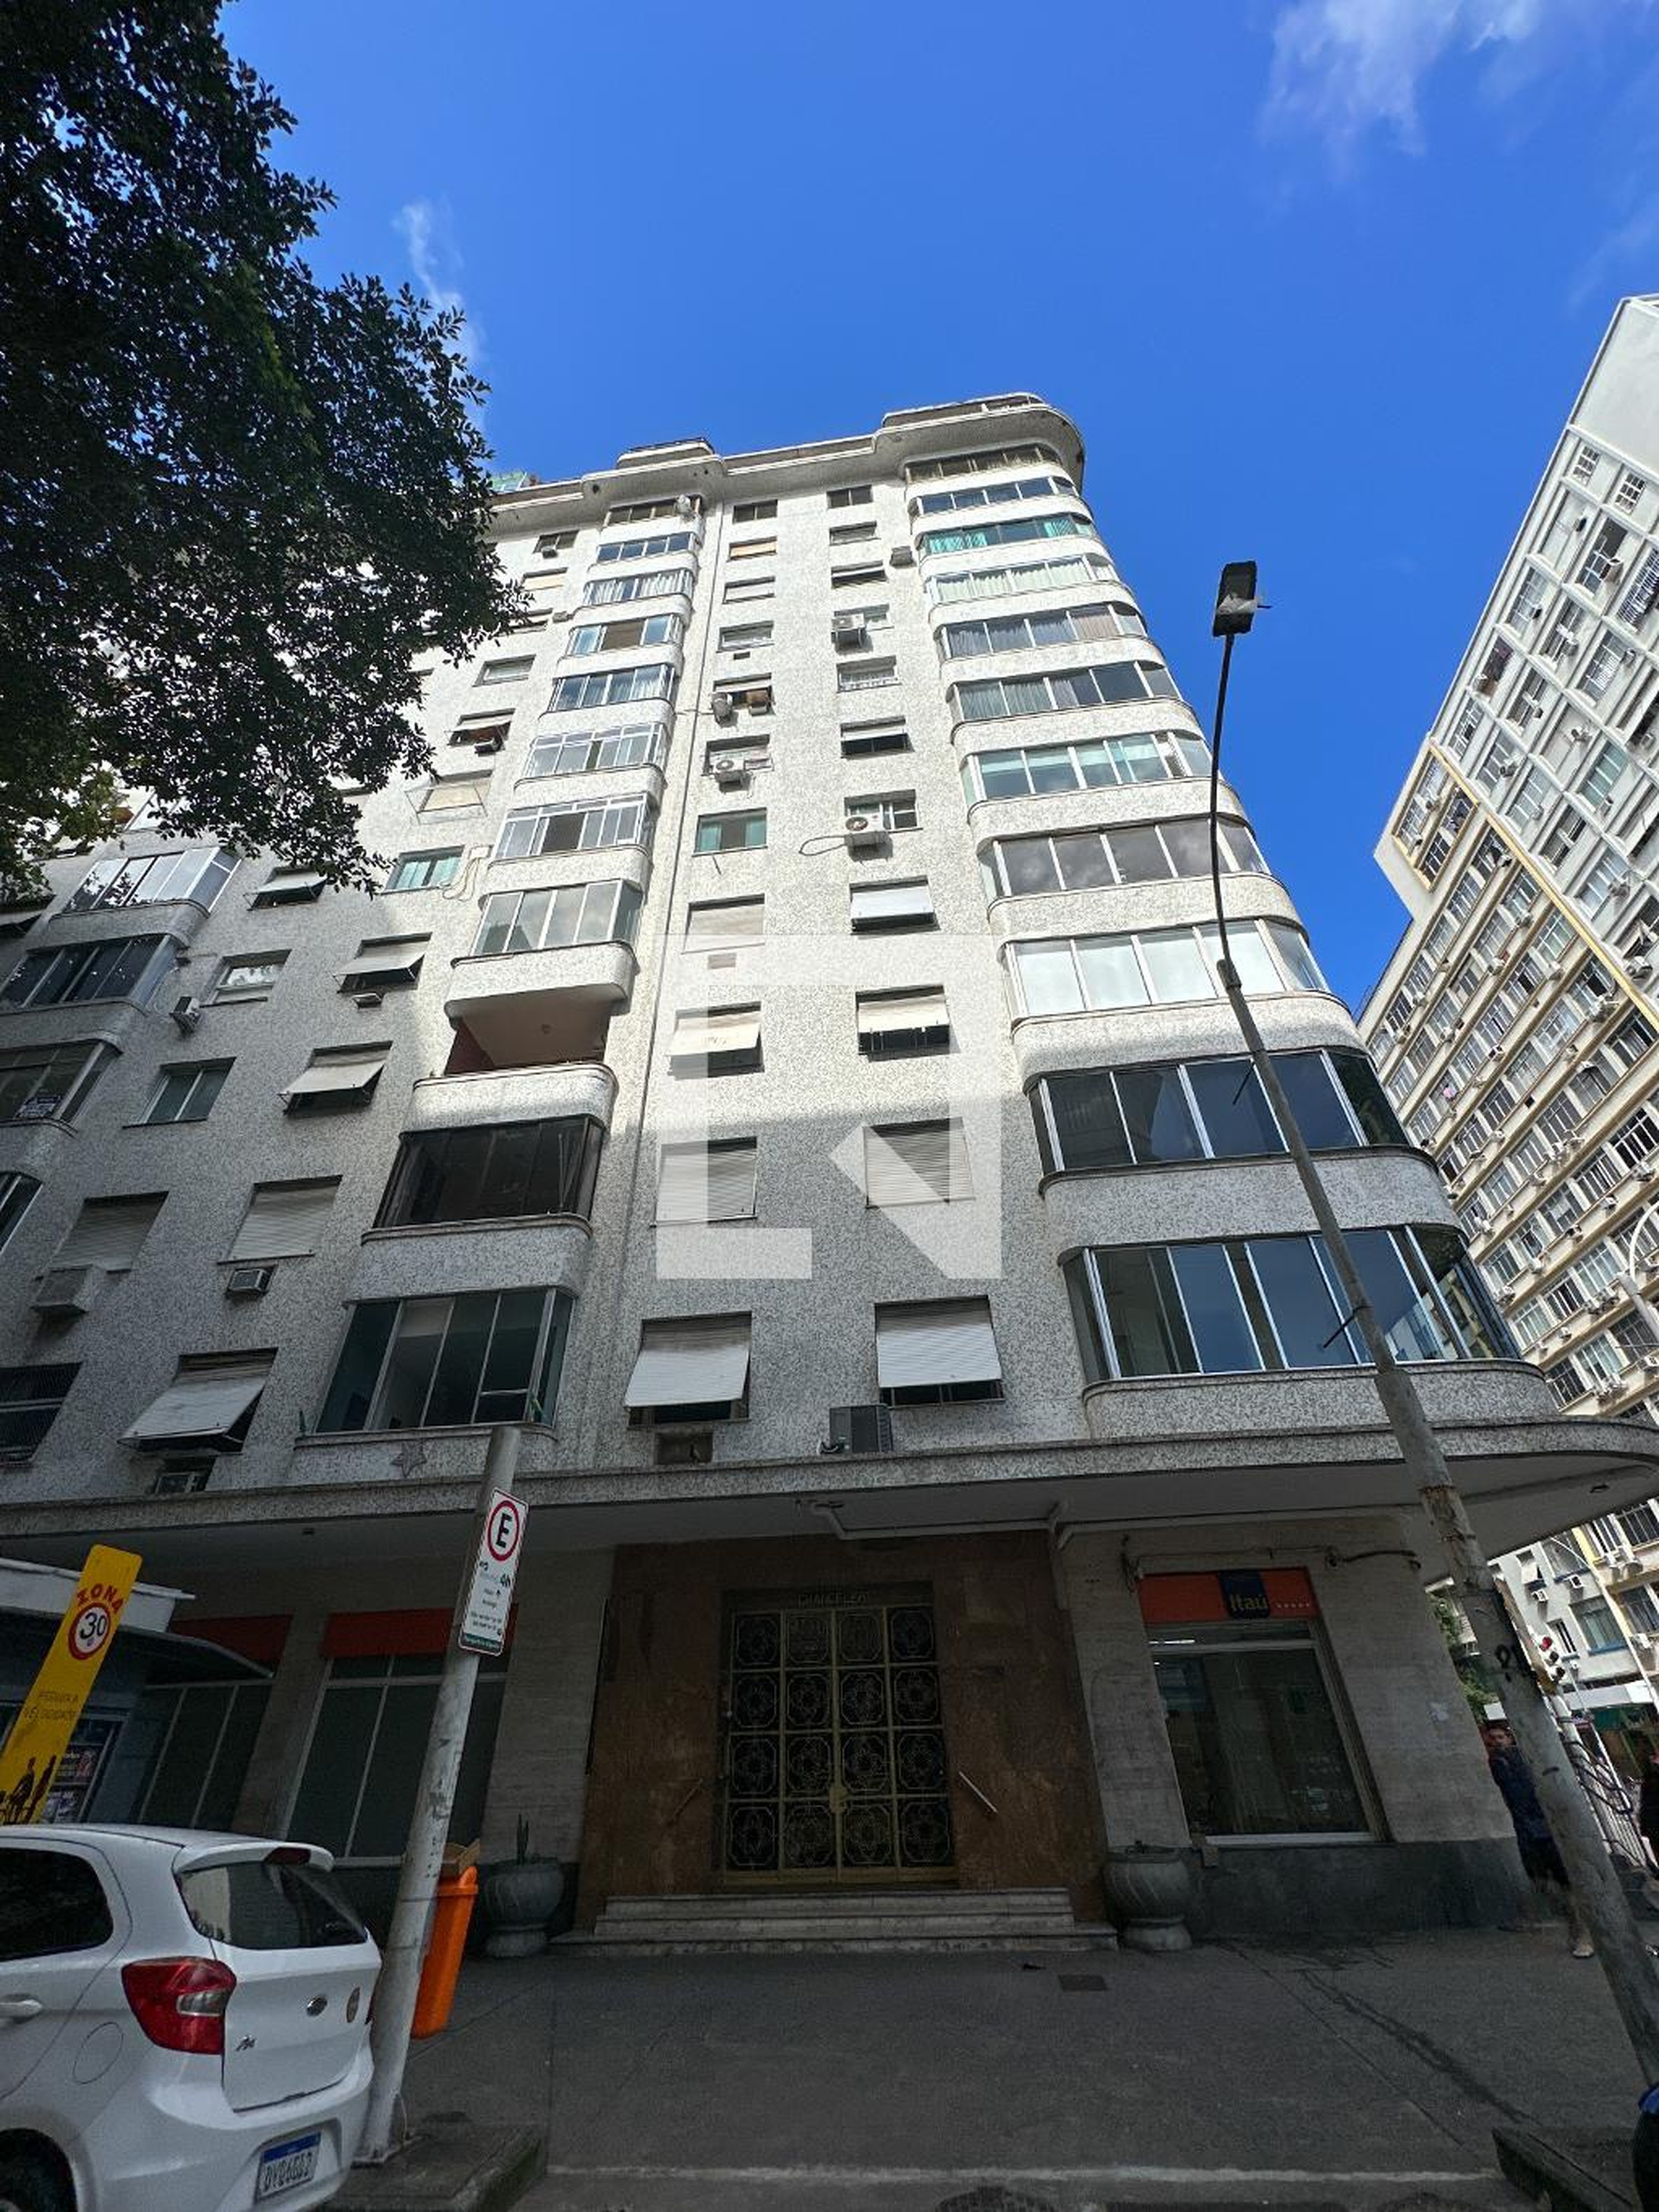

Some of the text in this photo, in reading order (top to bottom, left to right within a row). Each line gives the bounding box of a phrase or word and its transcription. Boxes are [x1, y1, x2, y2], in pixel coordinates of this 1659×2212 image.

[496, 1512, 512, 1549] E
[77, 1583, 124, 1614] ZONA
[80, 1612, 107, 1639] 30
